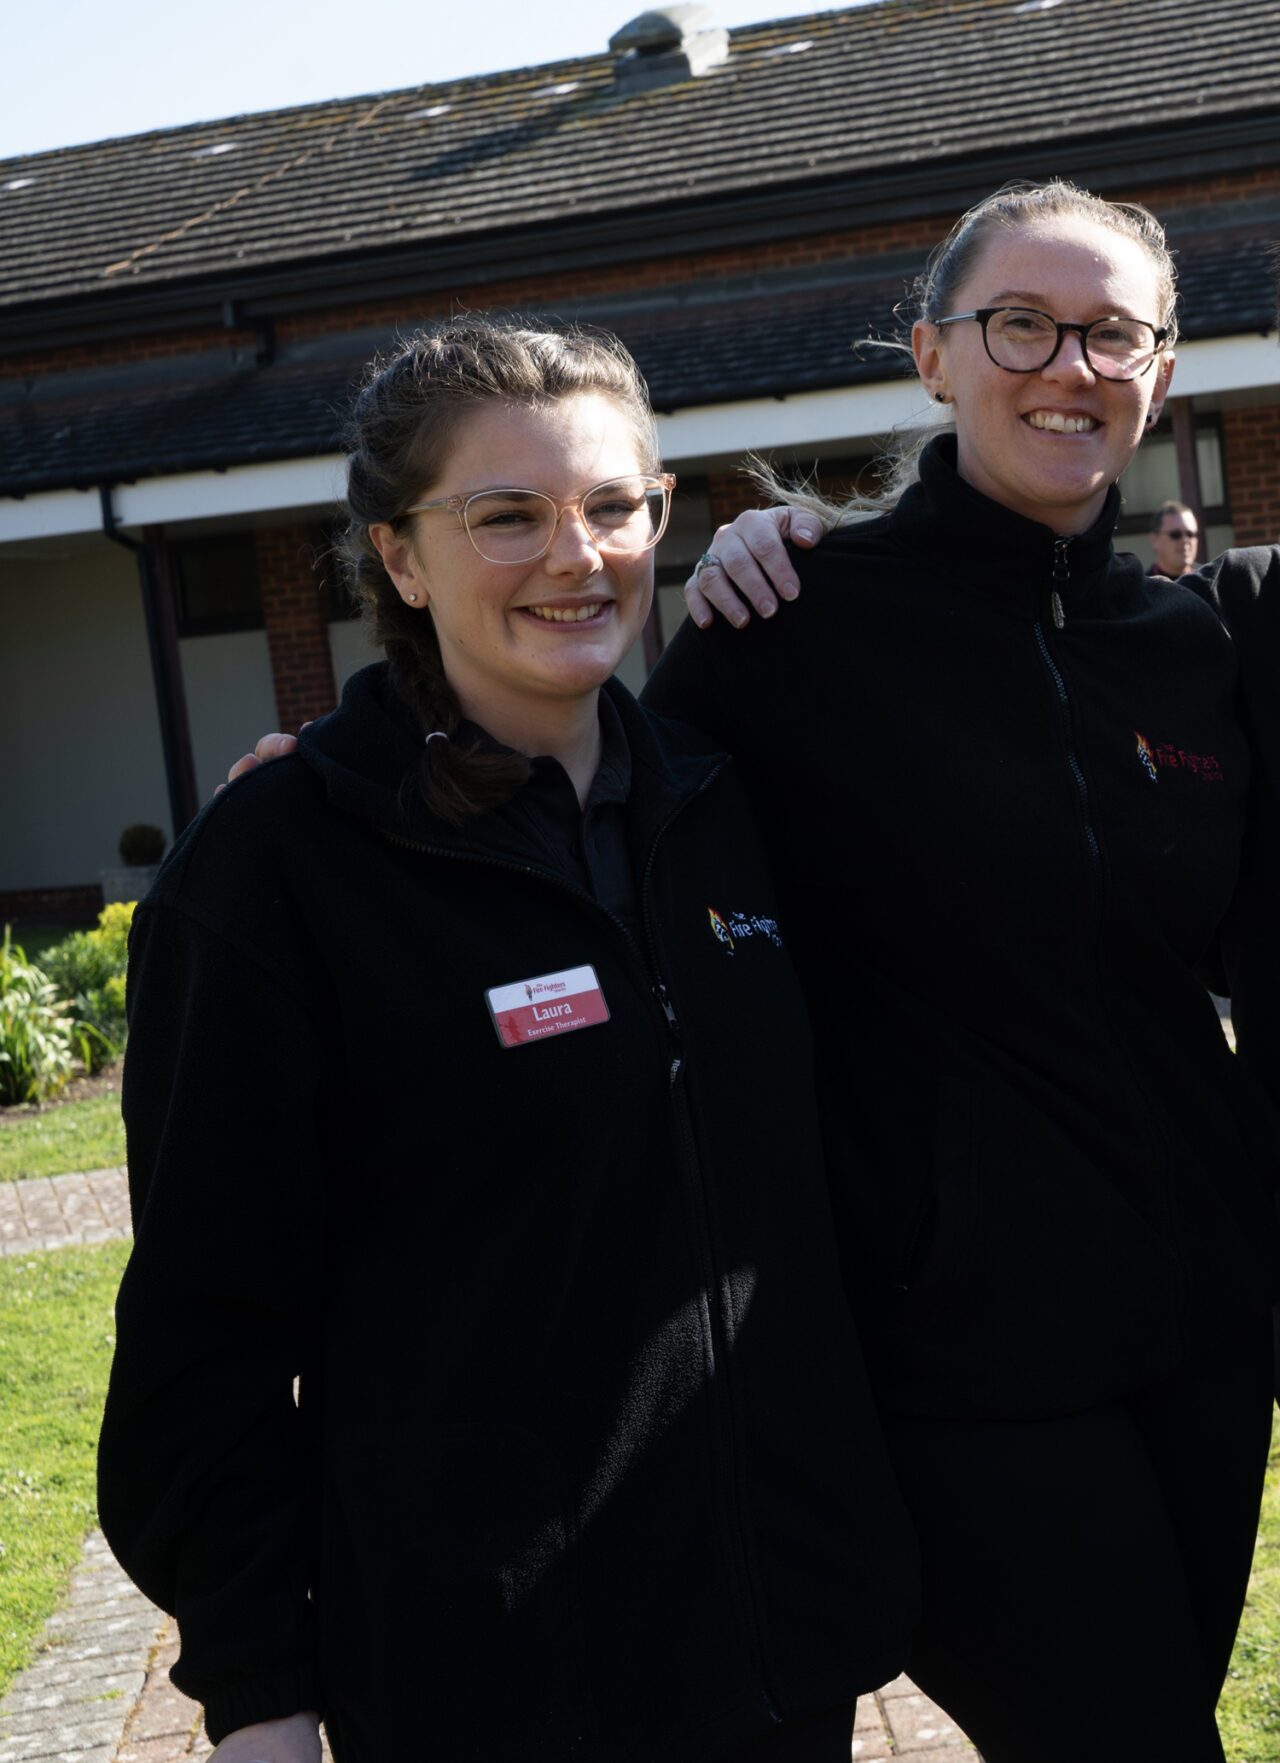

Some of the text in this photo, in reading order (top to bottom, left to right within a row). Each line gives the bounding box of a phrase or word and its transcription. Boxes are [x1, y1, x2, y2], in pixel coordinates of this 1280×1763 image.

[728, 919, 753, 938] Fire
[532, 1002, 573, 1021] Laura
[527, 1017, 587, 1037] Exercise Therapist
